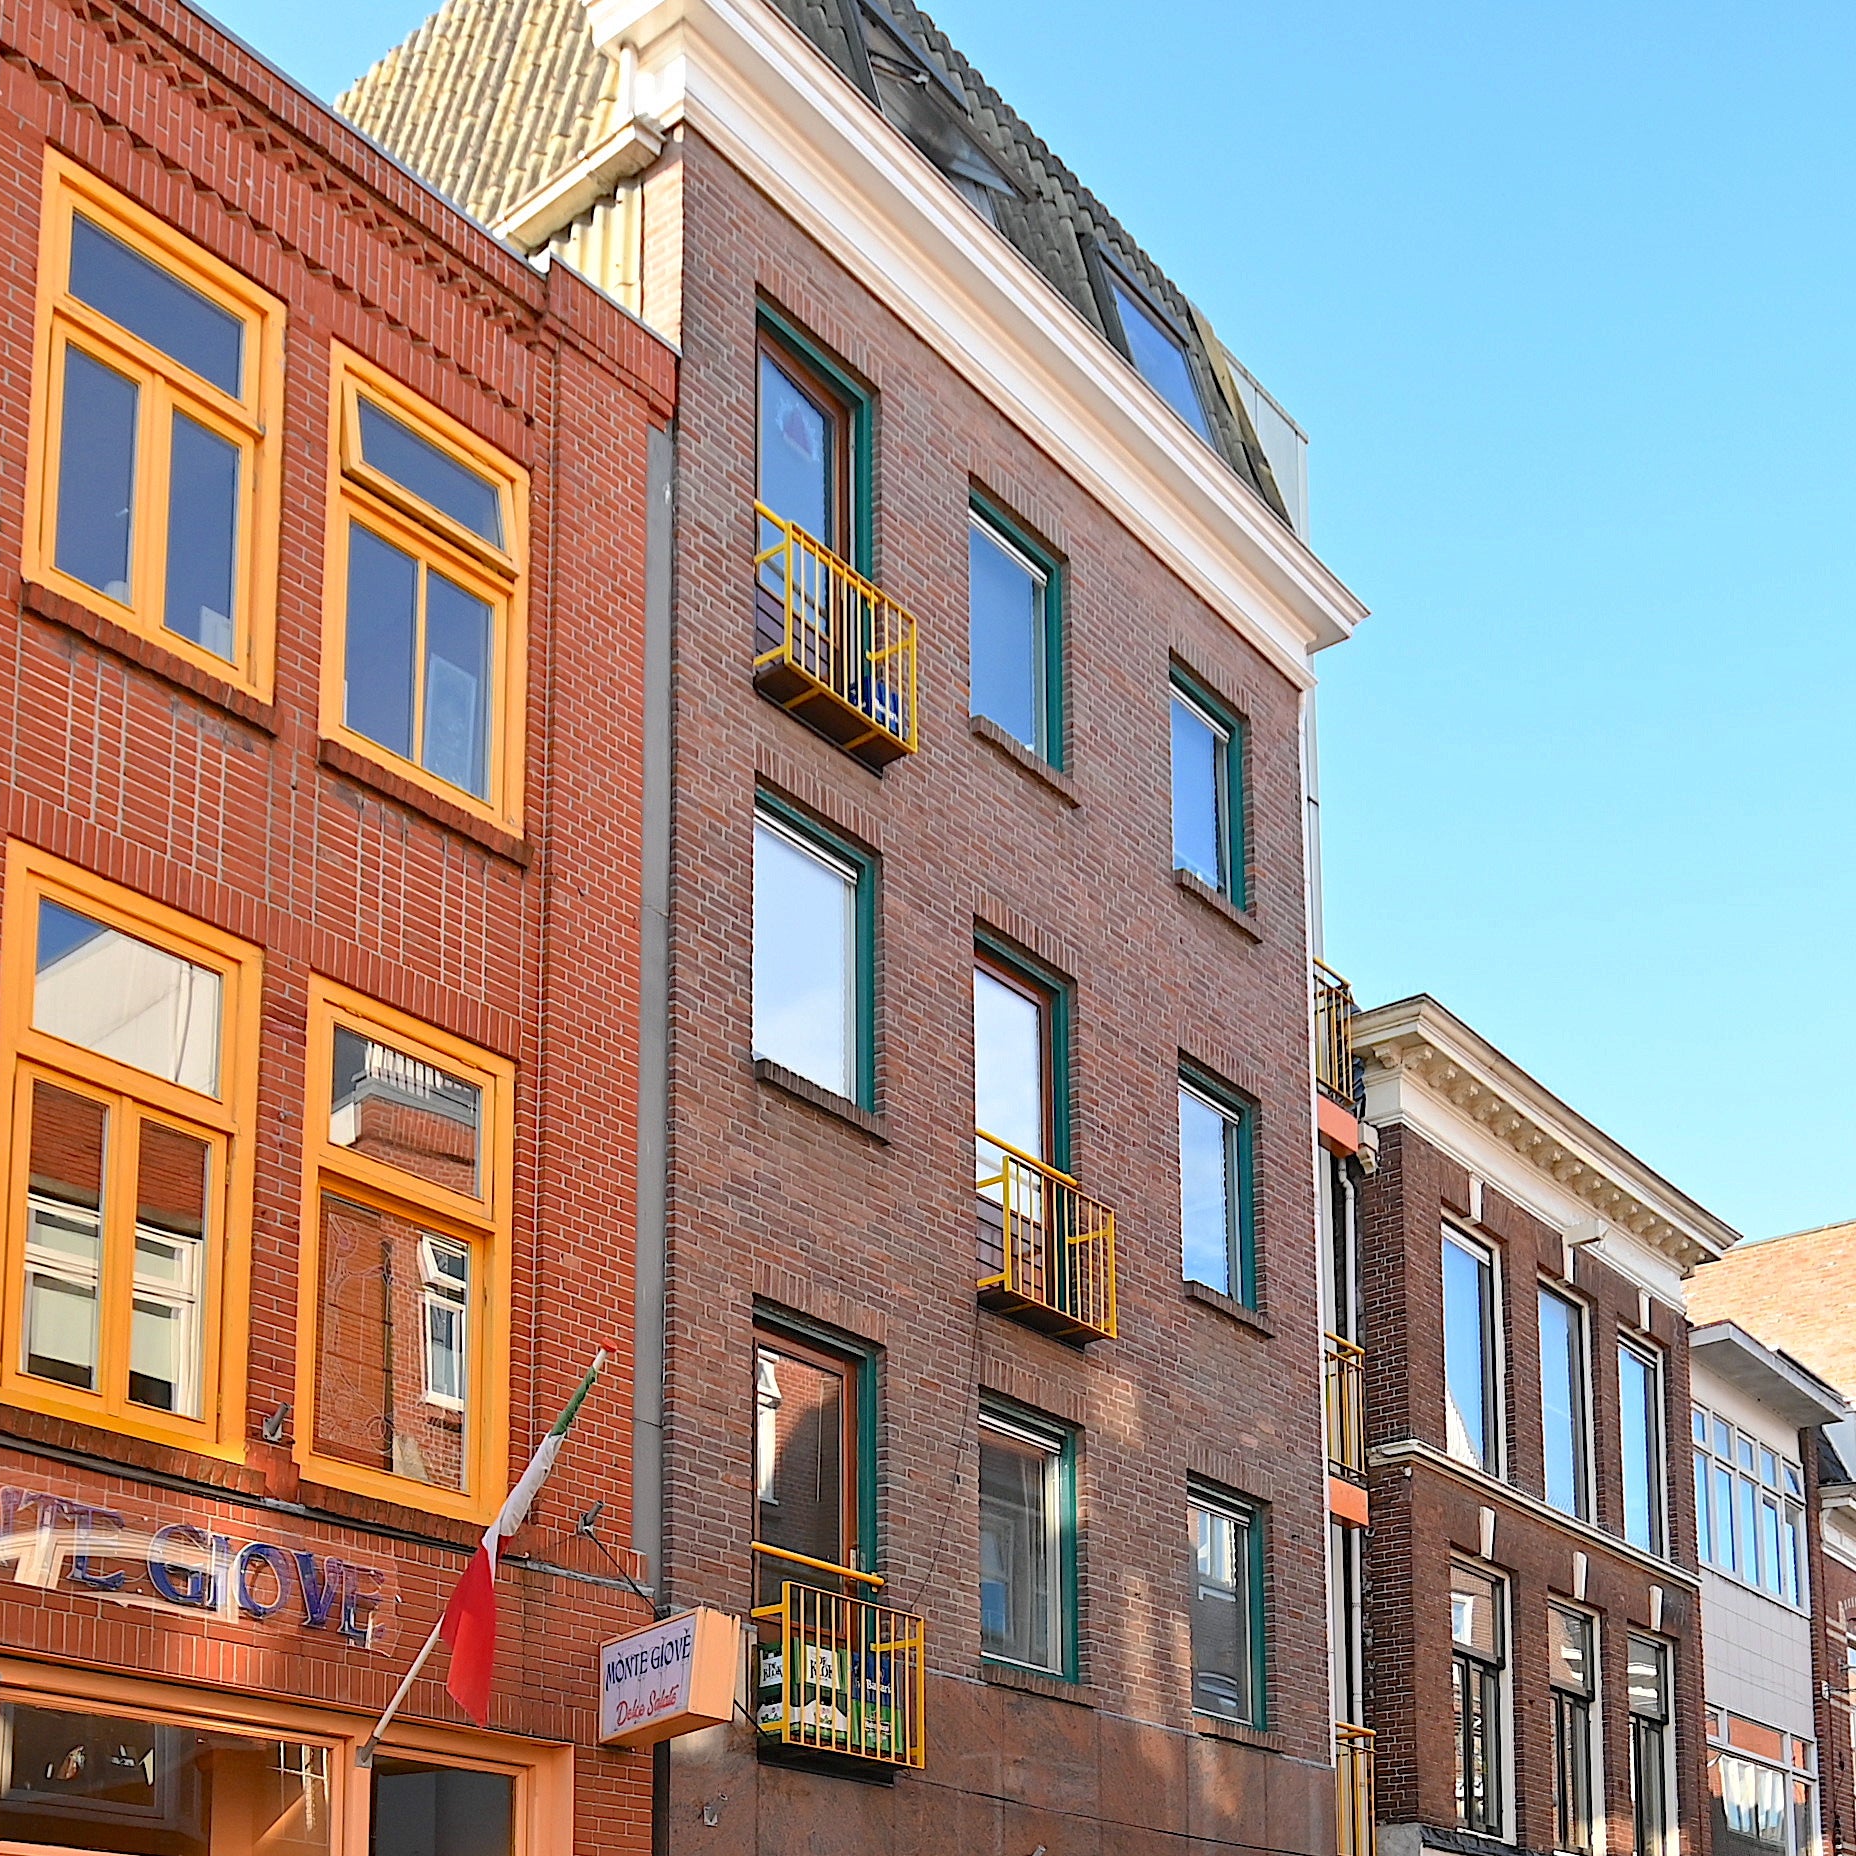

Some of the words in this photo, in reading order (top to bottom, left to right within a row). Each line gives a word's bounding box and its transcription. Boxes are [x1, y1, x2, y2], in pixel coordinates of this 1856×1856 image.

[146, 1522, 386, 1650] GIOVE
[605, 1650, 648, 1691] MONTE
[650, 1634, 692, 1670] GIOVE
